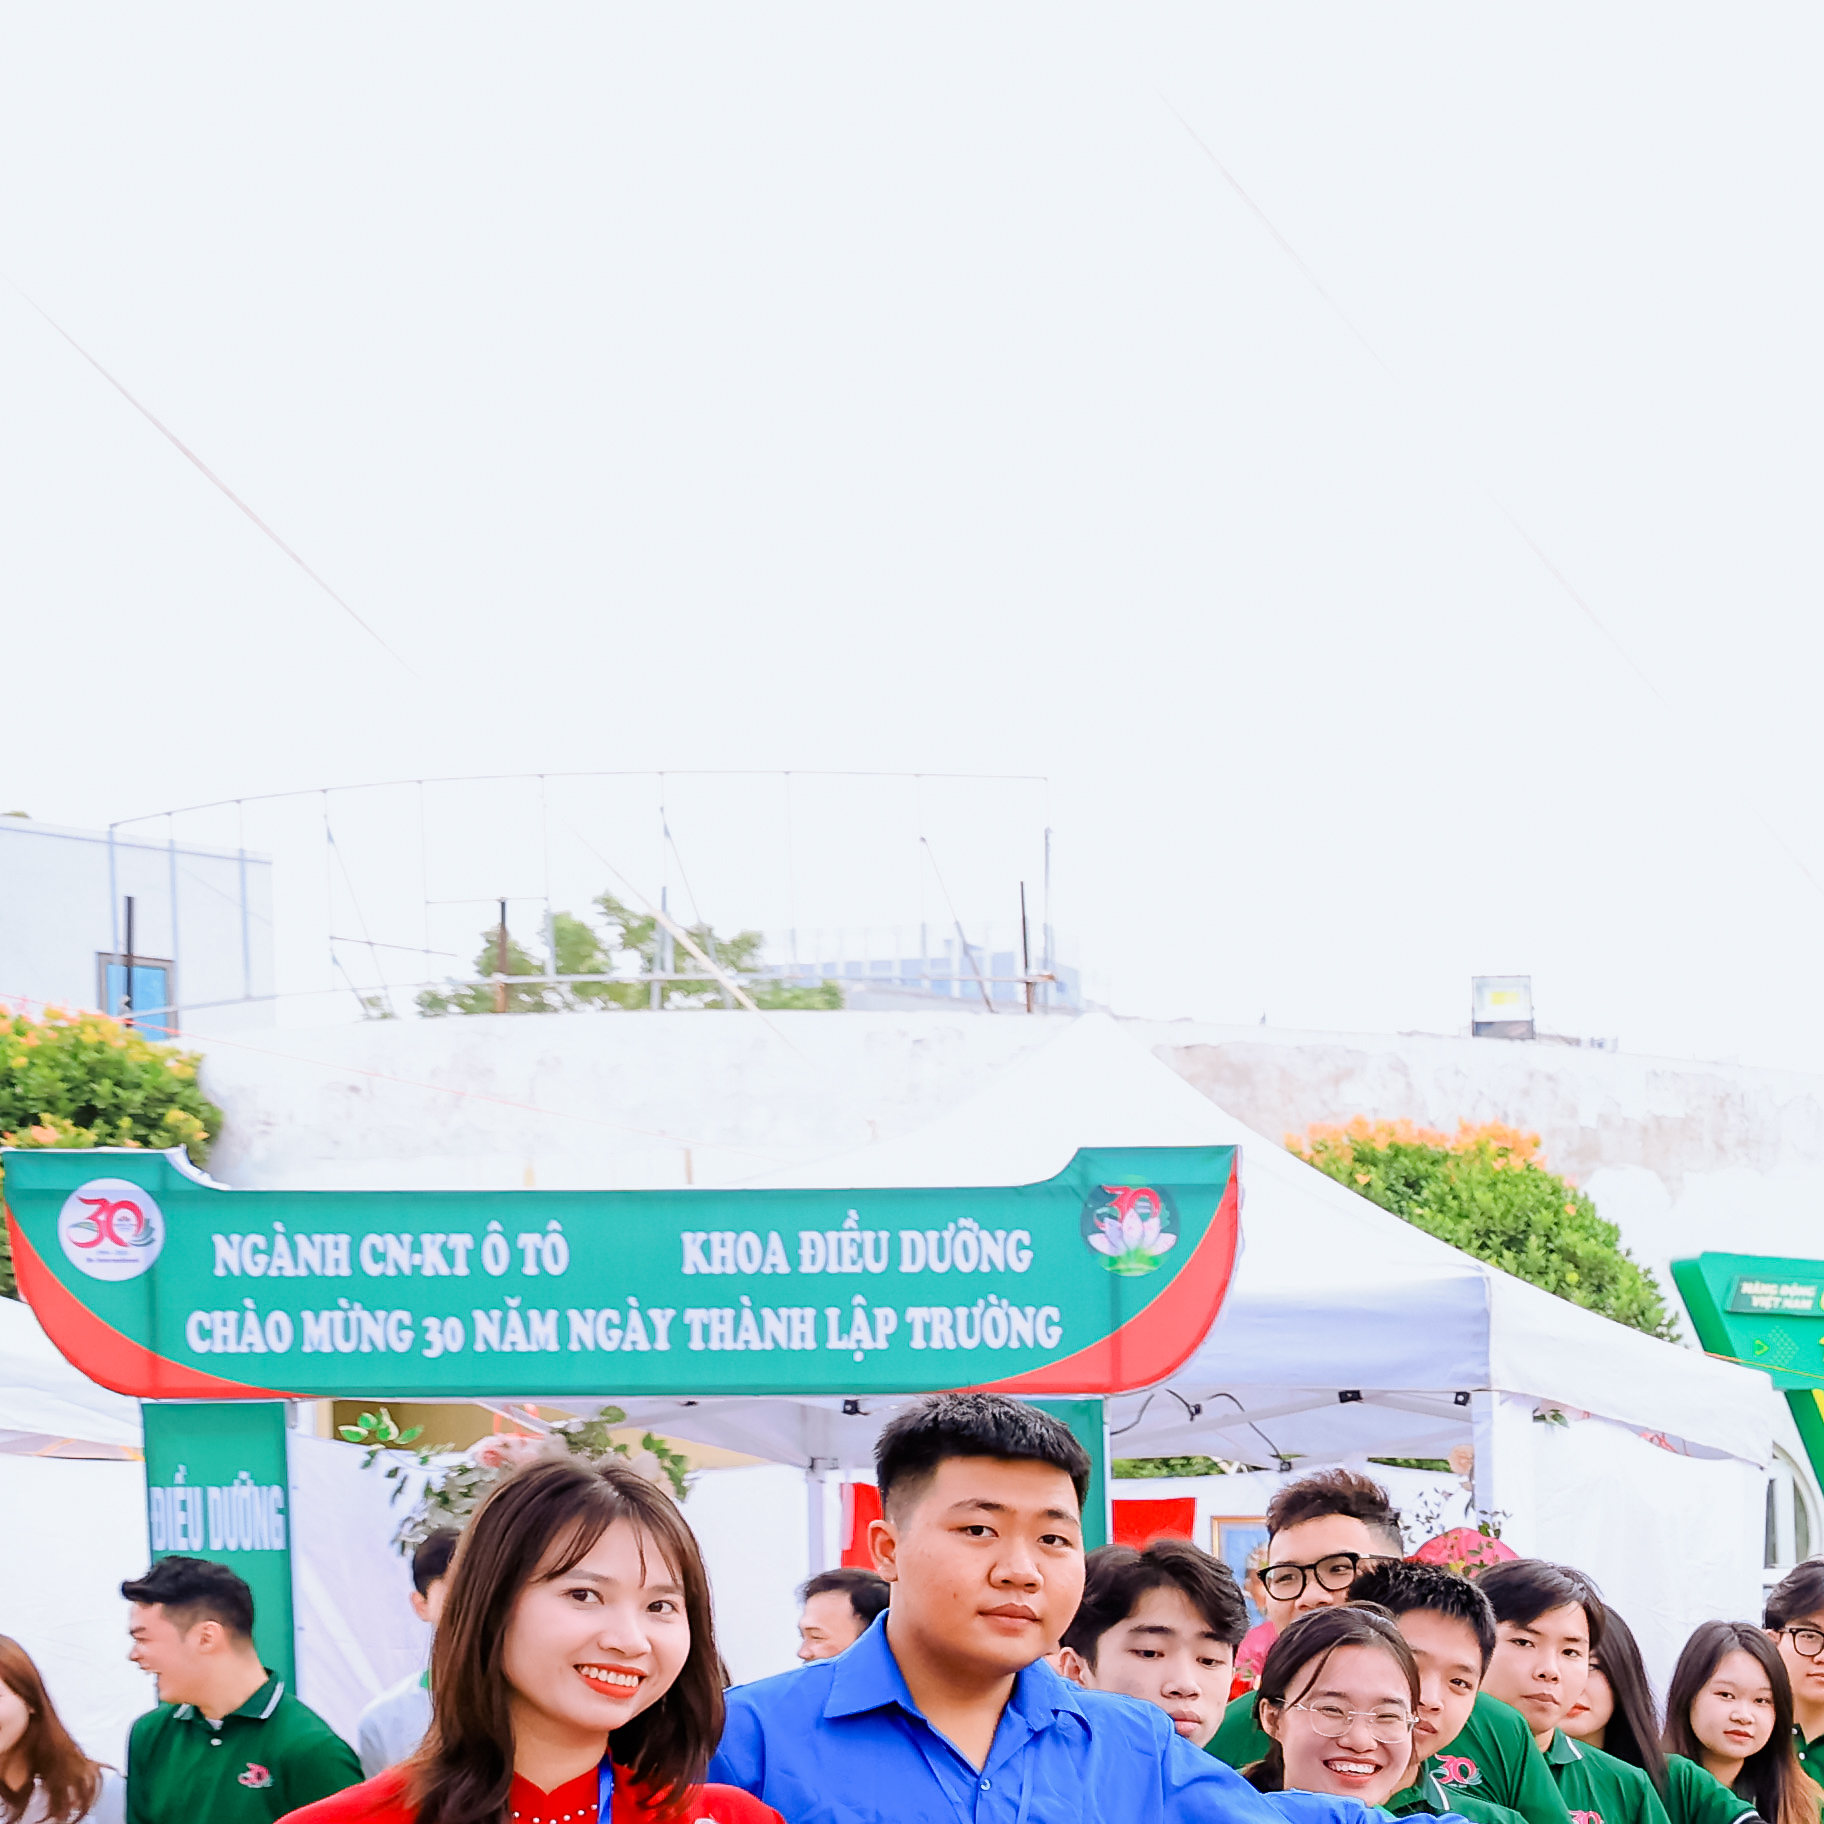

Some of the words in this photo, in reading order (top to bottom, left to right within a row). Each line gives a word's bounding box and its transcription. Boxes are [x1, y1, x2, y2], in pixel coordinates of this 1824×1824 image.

[212, 1221, 353, 1277] NGÀNH
[359, 1233, 475, 1277] CN-KT
[481, 1220, 510, 1277] Ô
[516, 1220, 571, 1277] TÔ
[680, 1230, 792, 1274] KHOA
[797, 1209, 891, 1274] ĐIỀU
[899, 1217, 1034, 1274] DƯỠNG
[185, 1297, 295, 1354] CHÀO
[301, 1297, 416, 1354] MỪNG
[421, 1316, 466, 1358] 30
[472, 1296, 561, 1352] NĂM
[567, 1296, 677, 1352] NGÀY
[683, 1295, 817, 1351] THÀNH
[825, 1294, 898, 1362] LẬP
[905, 1294, 1063, 1350] TRƯỜNG
